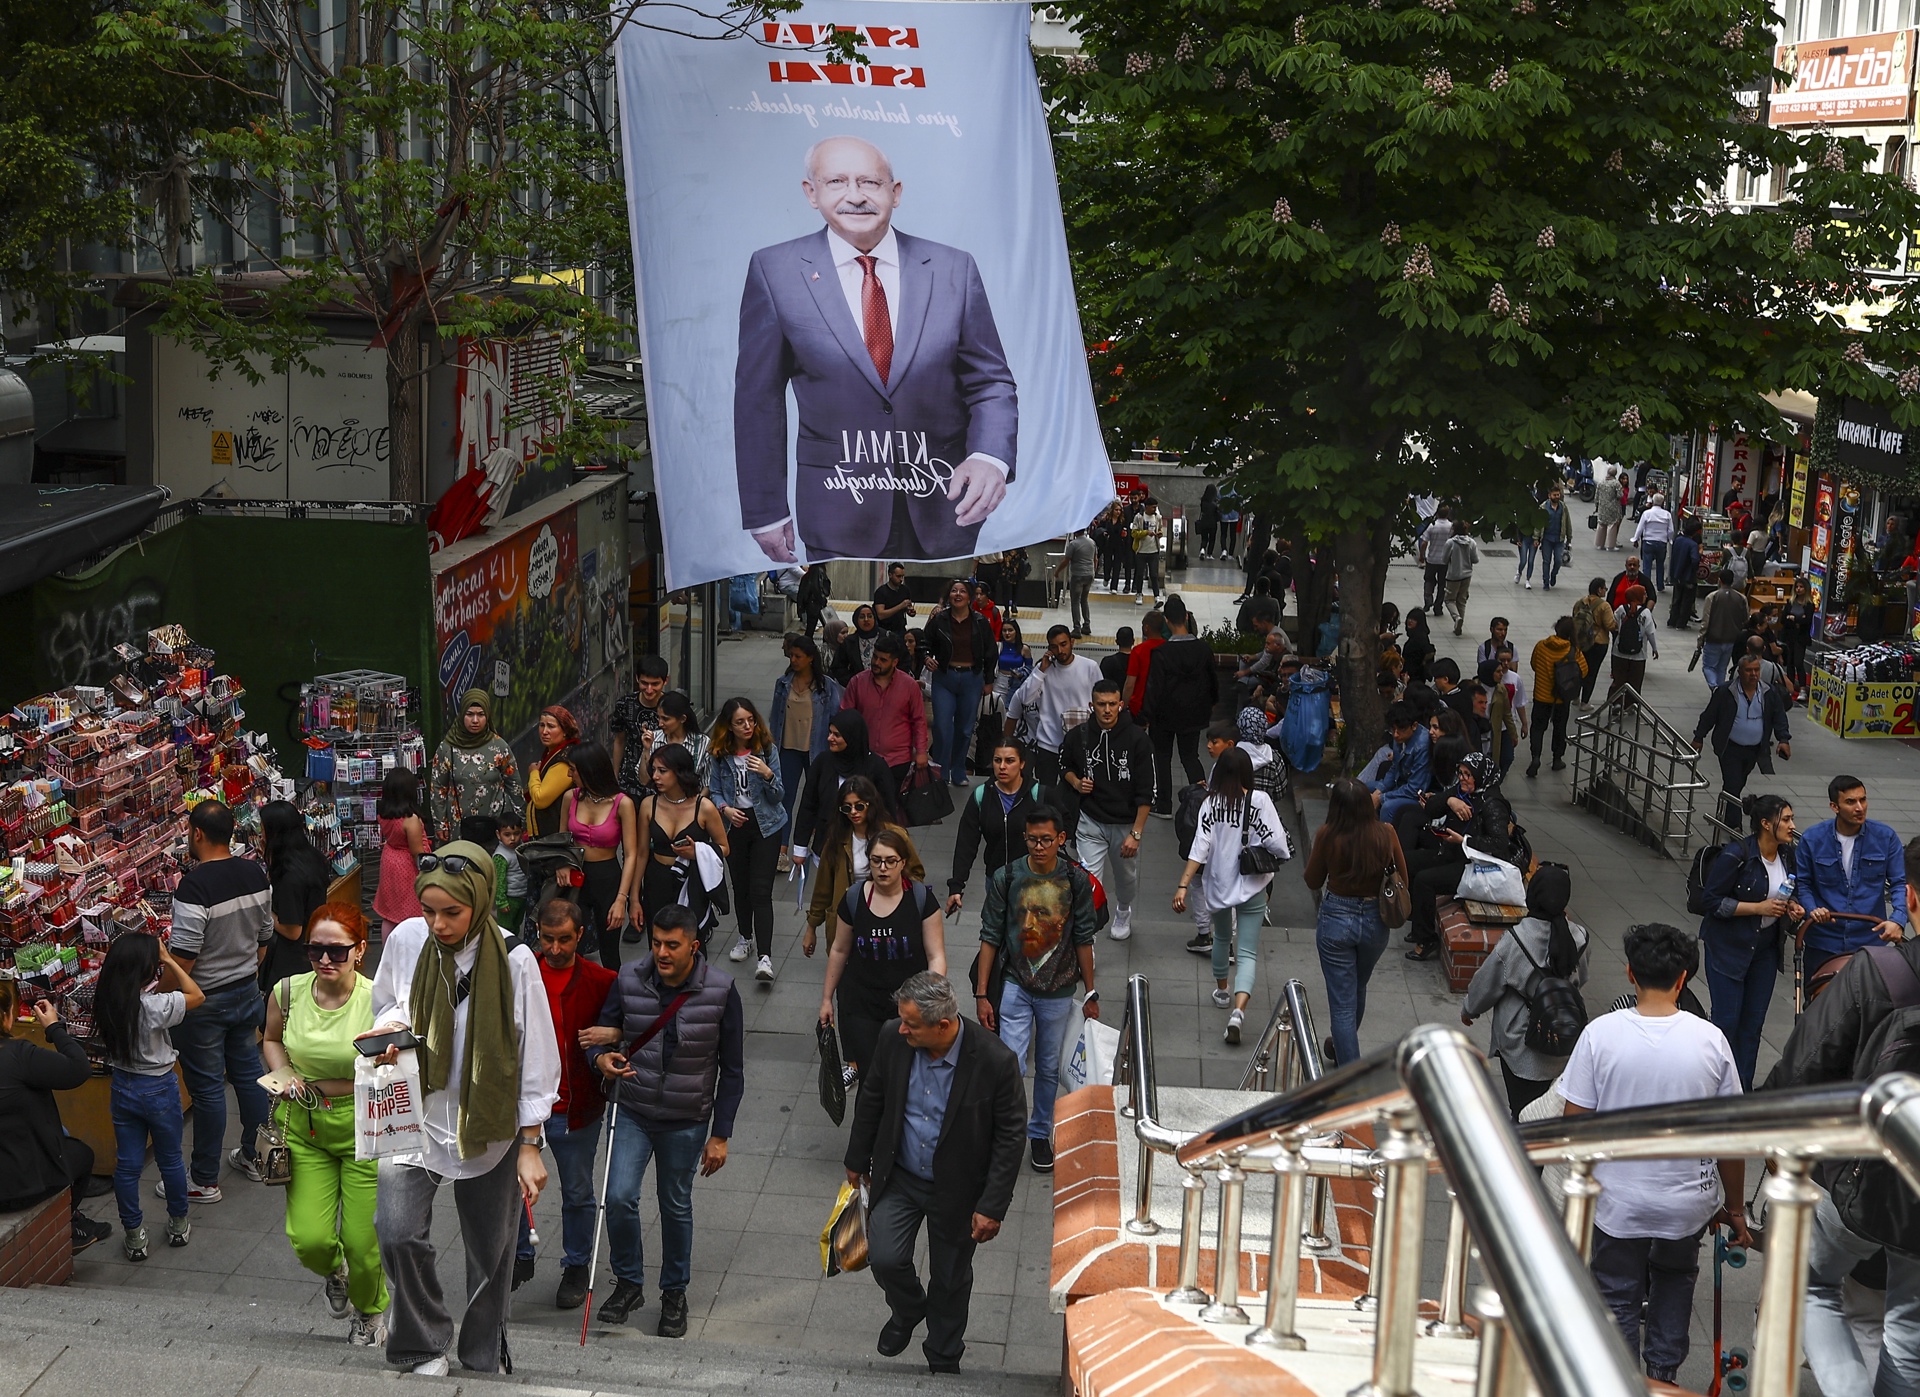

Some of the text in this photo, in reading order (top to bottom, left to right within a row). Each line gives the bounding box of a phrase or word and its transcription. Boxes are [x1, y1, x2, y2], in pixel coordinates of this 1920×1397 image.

[1802, 48, 1828, 59] ALESTA
[1798, 47, 1892, 91] KUAFÖR
[1879, 429, 1903, 455] KAFE
[1813, 671, 1819, 686] 3
[1855, 686, 1869, 702] 3
[1870, 689, 1889, 698] Adet
[871, 927, 893, 937] SELF
[857, 936, 913, 960] CTRL
[393, 1080, 412, 1115] FUARI
